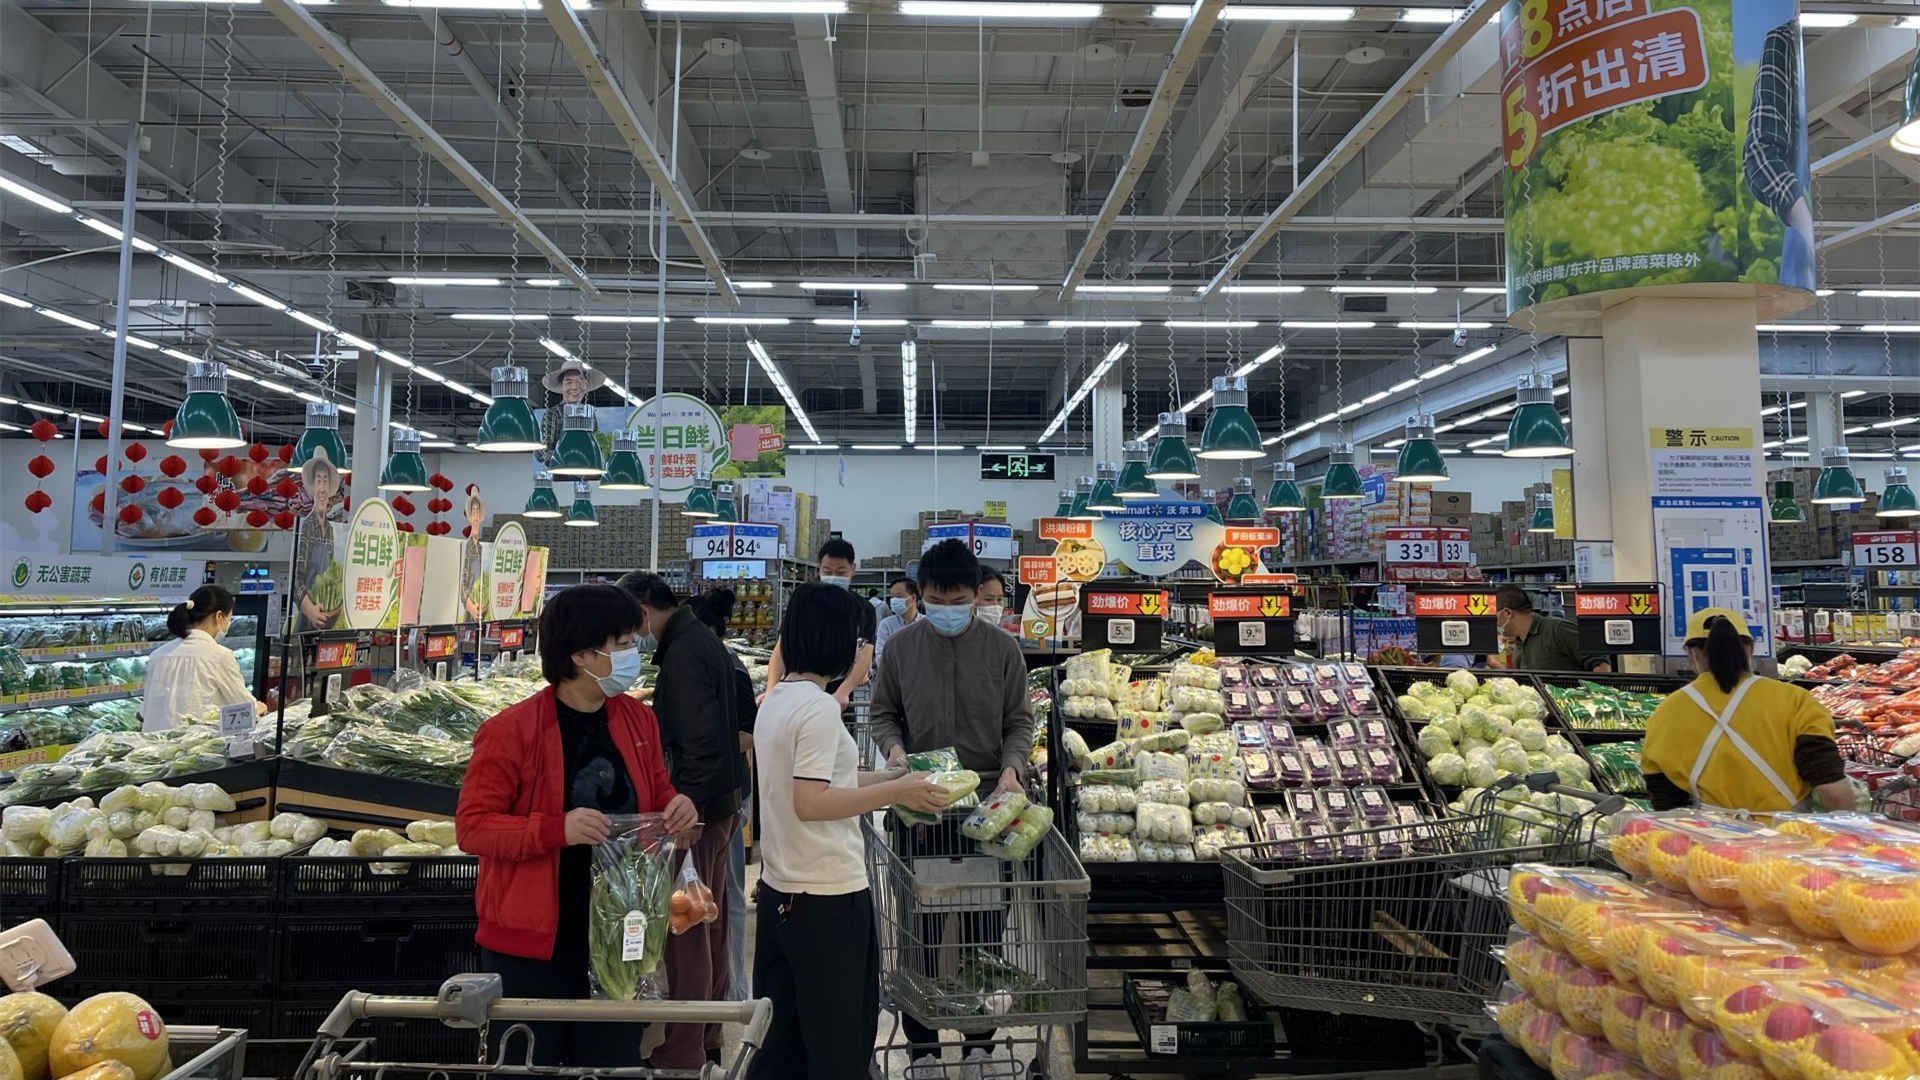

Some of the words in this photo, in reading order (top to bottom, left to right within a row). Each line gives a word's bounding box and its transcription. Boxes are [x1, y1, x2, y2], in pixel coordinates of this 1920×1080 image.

[1505, 32, 1687, 167] 5折出清
[637, 425, 709, 448] 当日鲜
[1665, 429, 1707, 447] 警示
[1167, 505, 1202, 515] 沃尔玛
[1119, 521, 1193, 541] 核心产区
[352, 530, 394, 567] 当日鲜
[1137, 543, 1174, 561] 直采
[1864, 546, 1905, 564] 158
[495, 547, 524, 576] 当日鲜
[37, 565, 92, 584] 无公害蔬菜
[150, 567, 188, 583] 有机蔬菜
[1092, 595, 1129, 609] 劲爆价
[1213, 599, 1250, 612] 劲爆价
[1419, 597, 1457, 610] 劲爆价
[1580, 596, 1618, 610] 劲爆价
